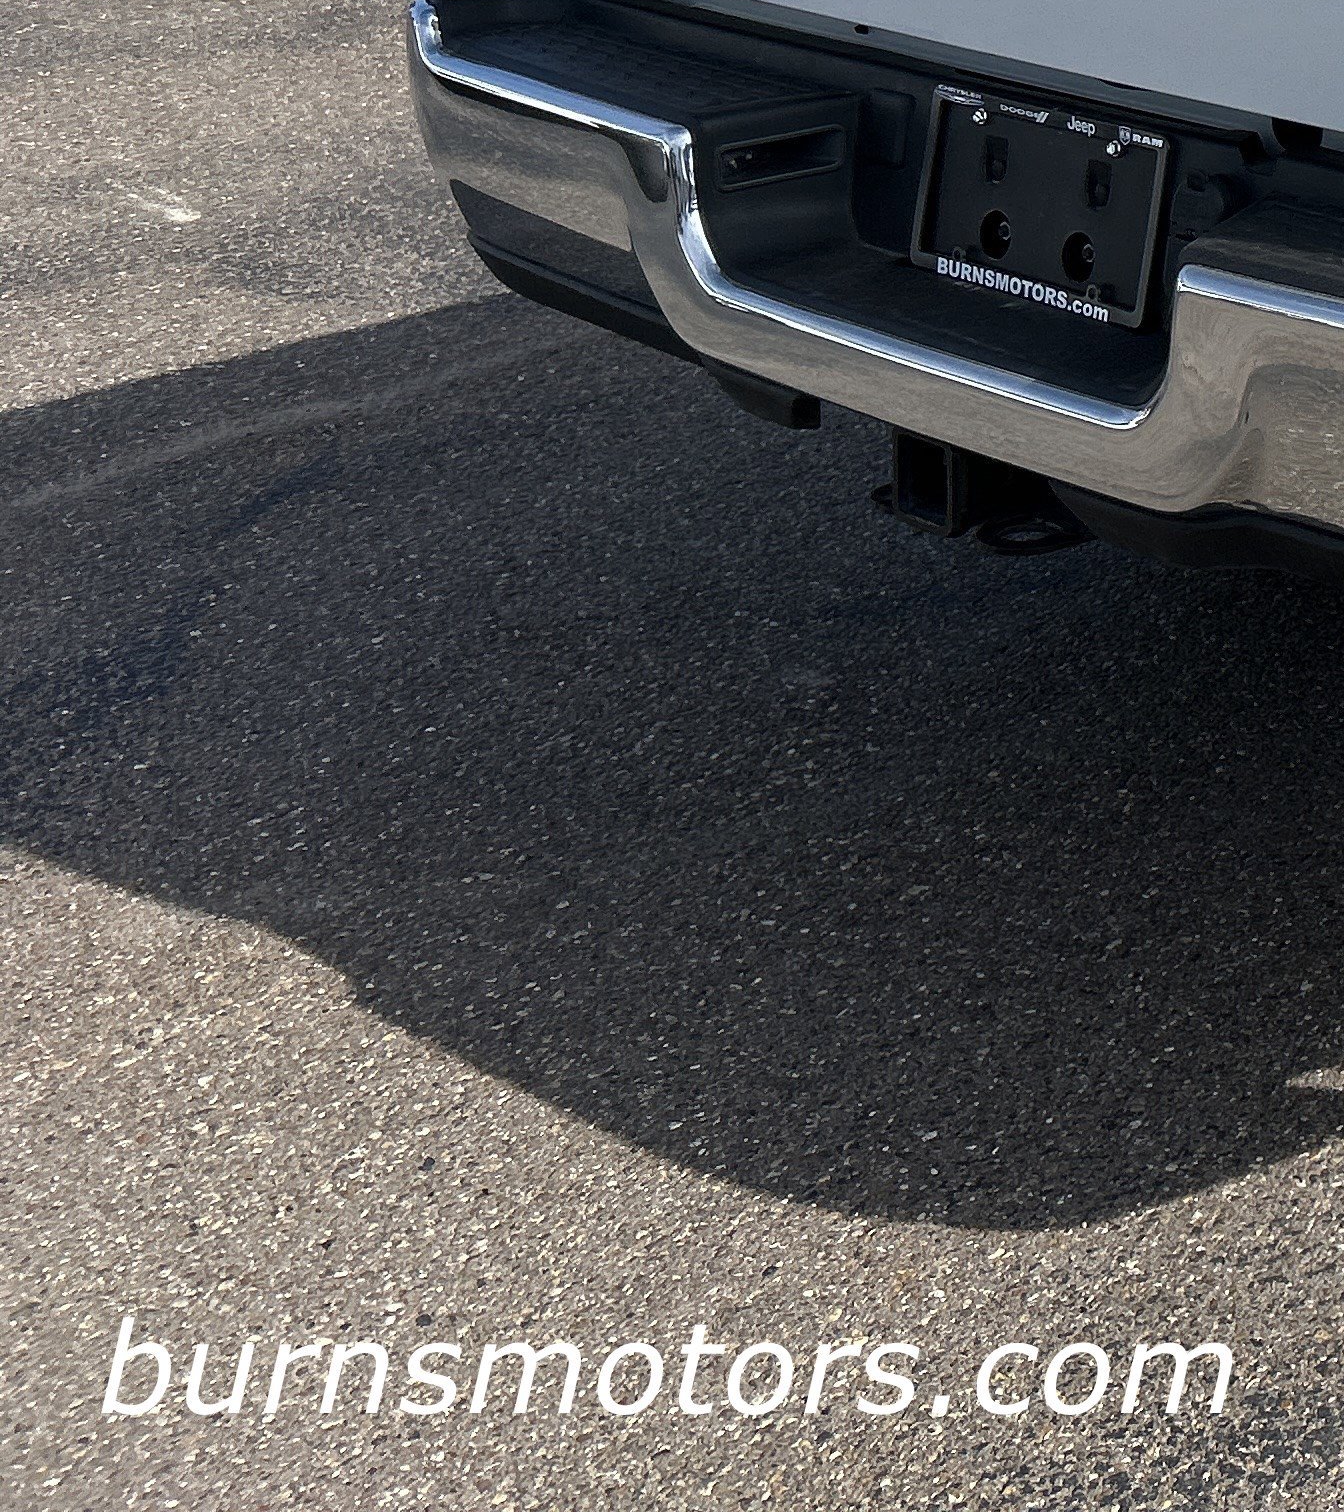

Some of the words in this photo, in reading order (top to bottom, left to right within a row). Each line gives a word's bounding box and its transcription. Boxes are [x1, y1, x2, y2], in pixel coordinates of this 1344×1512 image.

[1067, 115, 1096, 138] Jeep
[1132, 133, 1164, 148] RAM
[937, 257, 1109, 323] BURNSMOTORS.com
